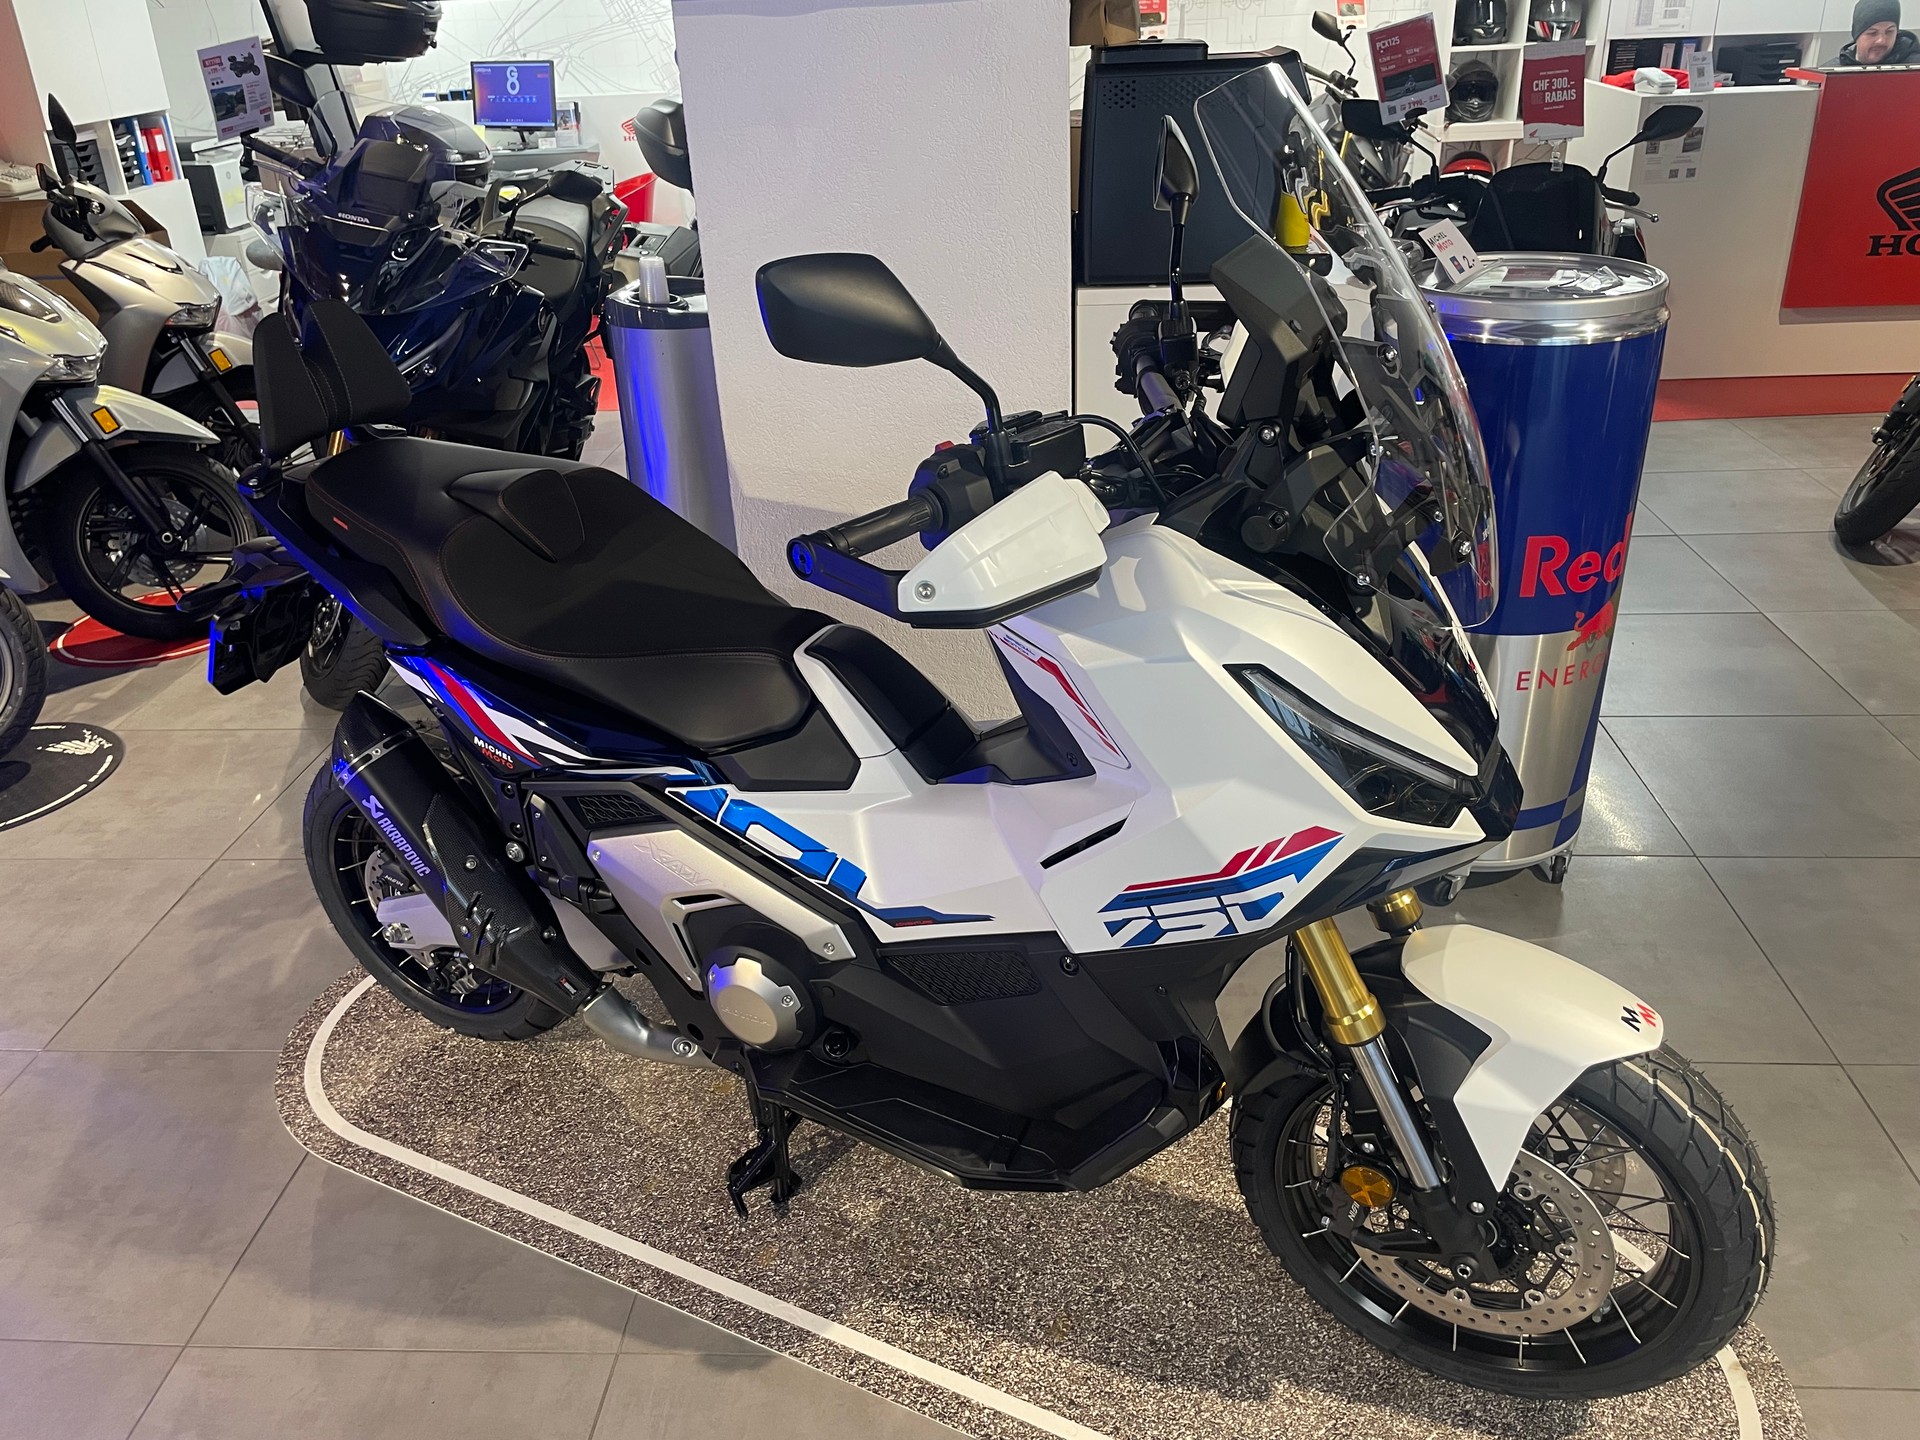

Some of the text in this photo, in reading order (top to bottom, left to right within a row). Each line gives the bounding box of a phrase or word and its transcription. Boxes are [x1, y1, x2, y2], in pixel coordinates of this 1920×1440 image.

[1375, 36, 1400, 50] PCX125
[1533, 77, 1575, 91] CHF 300.-
[1545, 89, 1577, 103] RABAIS
[337, 212, 370, 224] HONDA
[1519, 511, 1633, 598] Red
[473, 735, 514, 763] MICHEL
[481, 747, 514, 769] MOTO
[1098, 872, 1300, 949] 750
